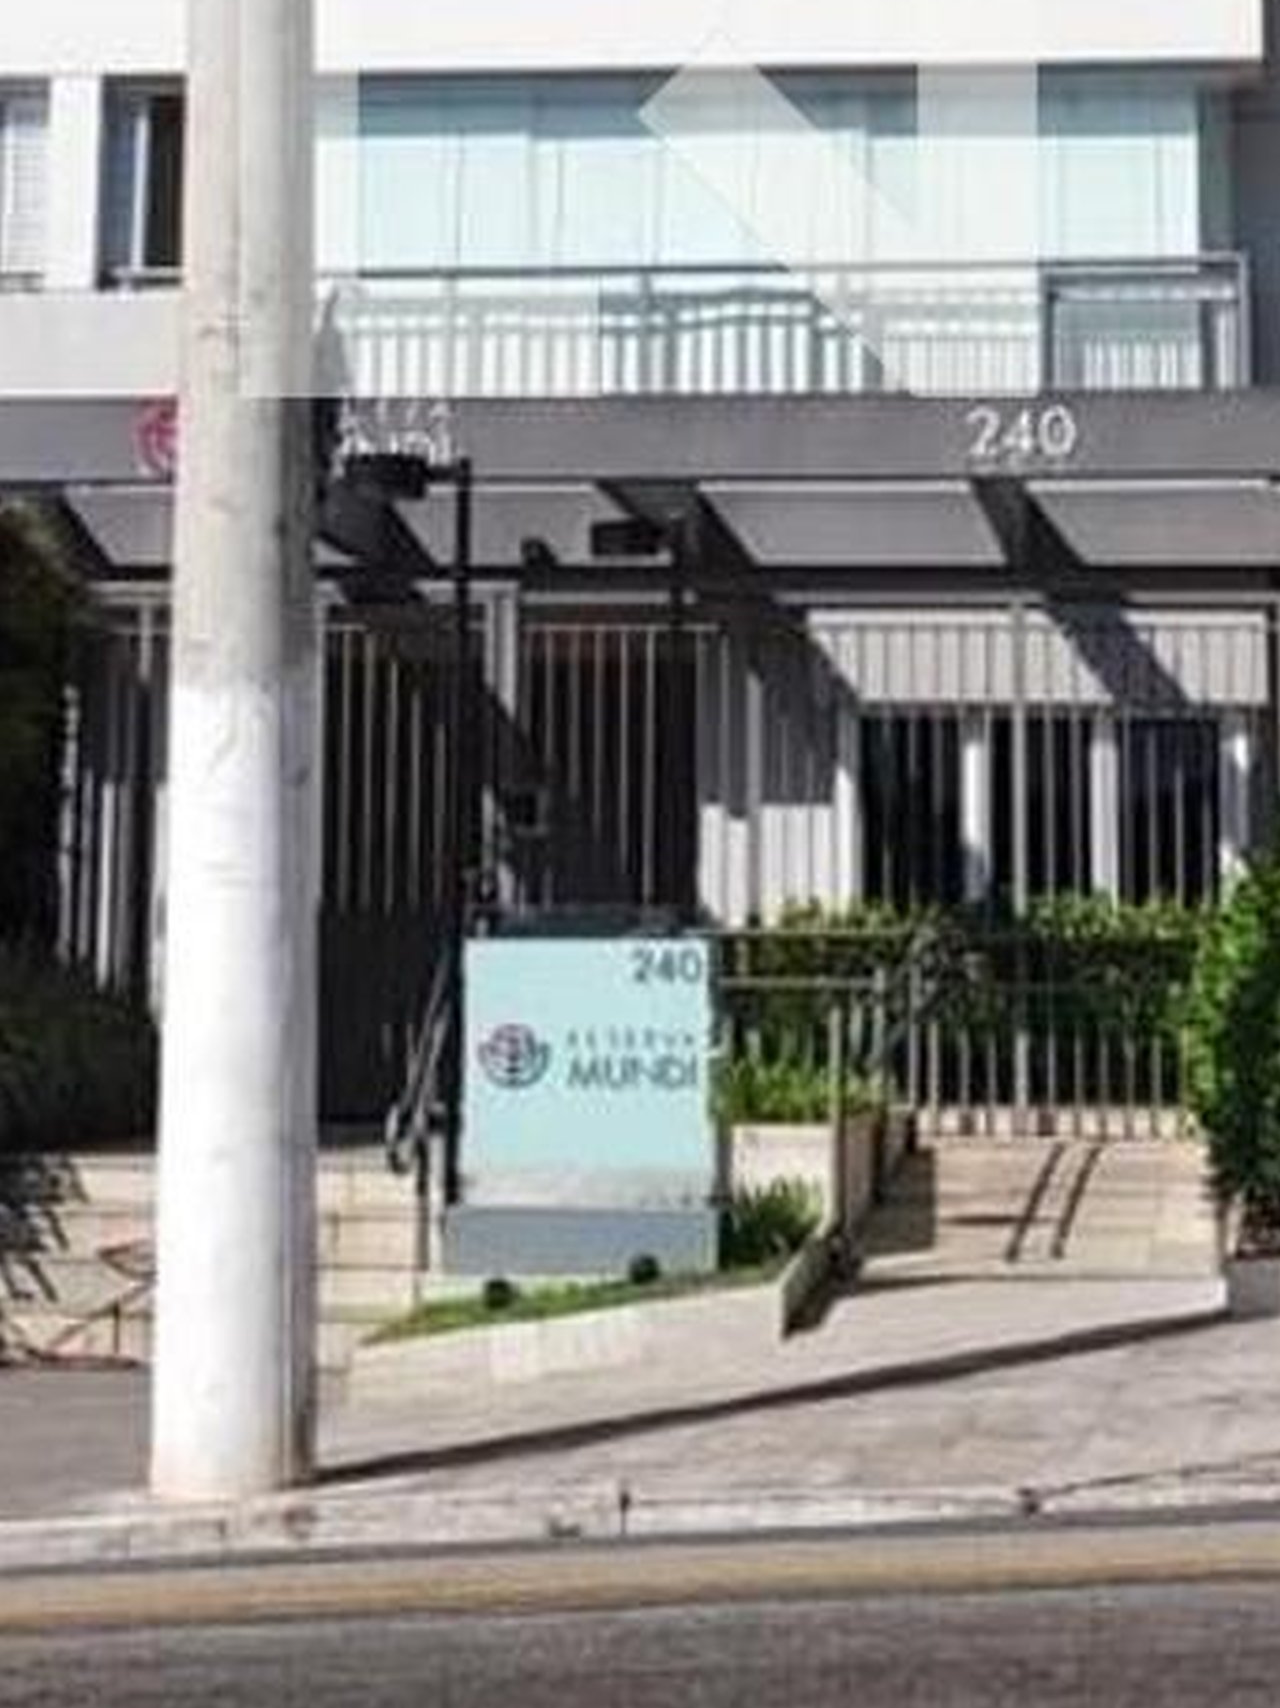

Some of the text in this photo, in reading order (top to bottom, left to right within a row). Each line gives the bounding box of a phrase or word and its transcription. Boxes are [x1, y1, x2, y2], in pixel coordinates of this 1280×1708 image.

[967, 405, 1077, 456] 240
[632, 948, 702, 984] 240
[569, 1056, 698, 1089] MUNDI
